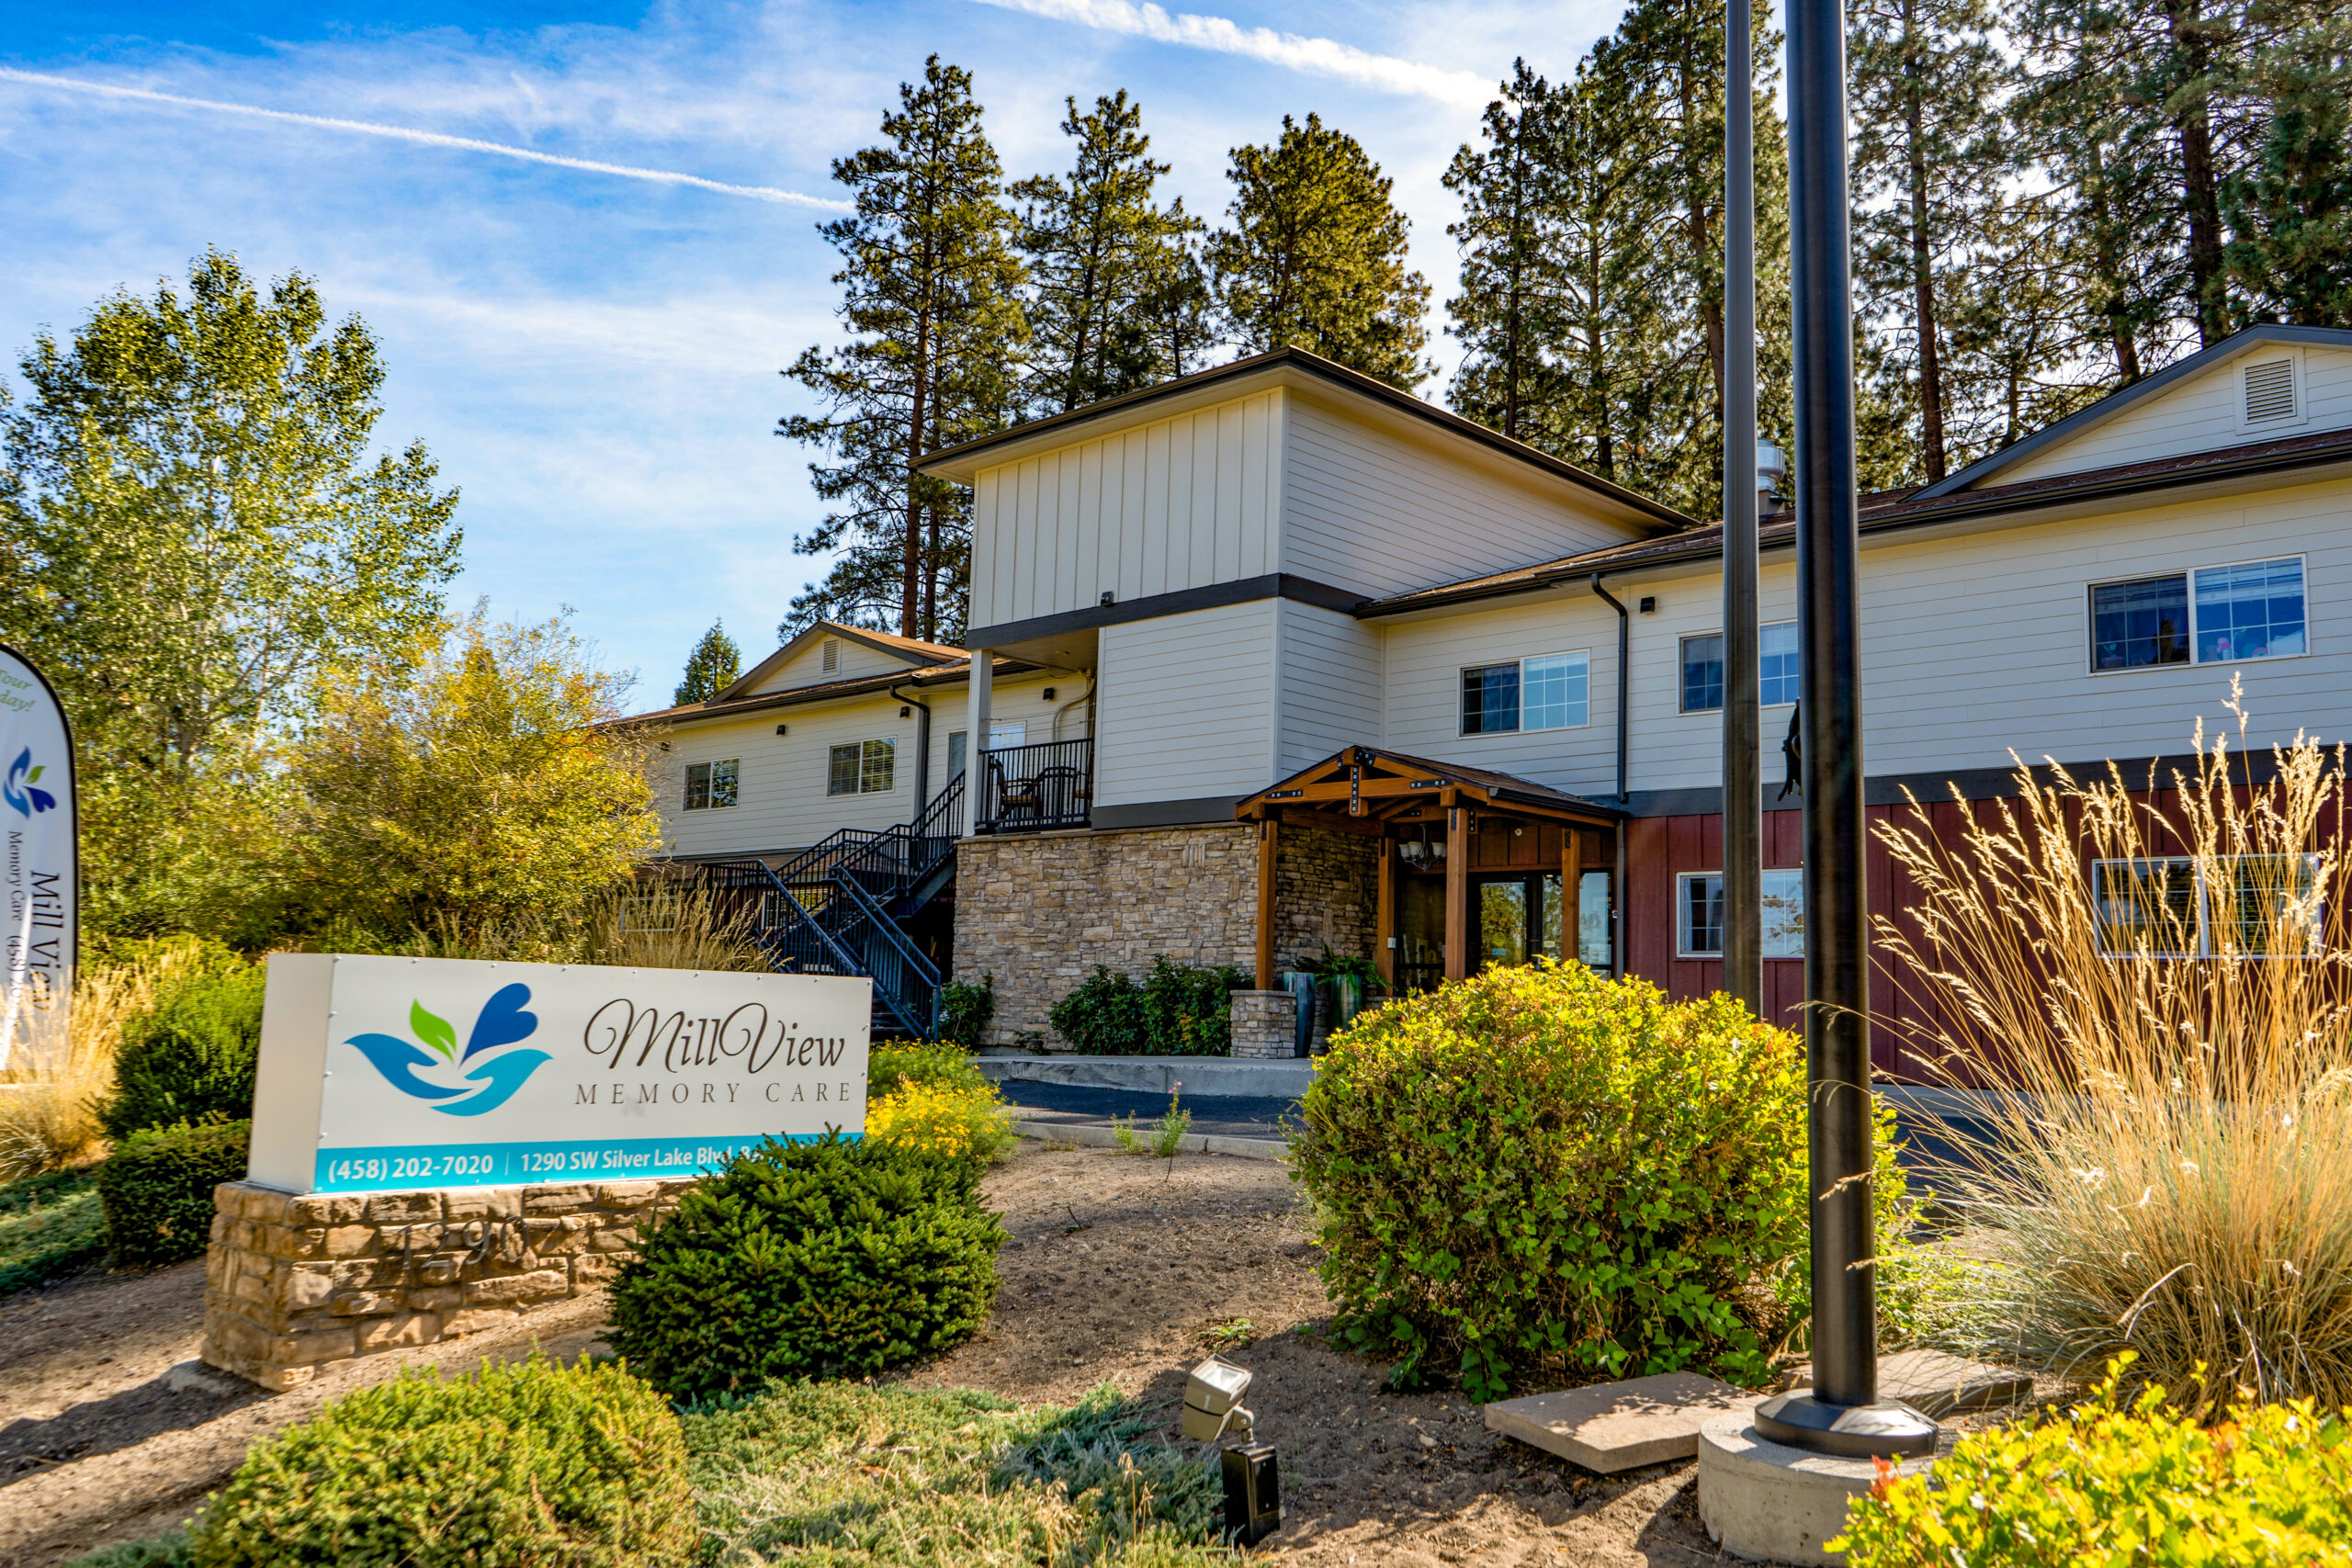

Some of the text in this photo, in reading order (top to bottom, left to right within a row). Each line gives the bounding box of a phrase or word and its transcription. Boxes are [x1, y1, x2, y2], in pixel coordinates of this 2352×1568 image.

[6, 830, 23, 886] Memory
[10, 890, 26, 921] Care
[30, 870, 64, 929] Mill
[575, 1082, 851, 1105] MEMORY CARE
[328, 1158, 389, 1183] (458)
[391, 1155, 494, 1179] 202-7020
[521, 1152, 566, 1172] 1290
[570, 1150, 599, 1170] SW
[602, 1149, 650, 1168] Silver
[654, 1147, 693, 1167] Lake
